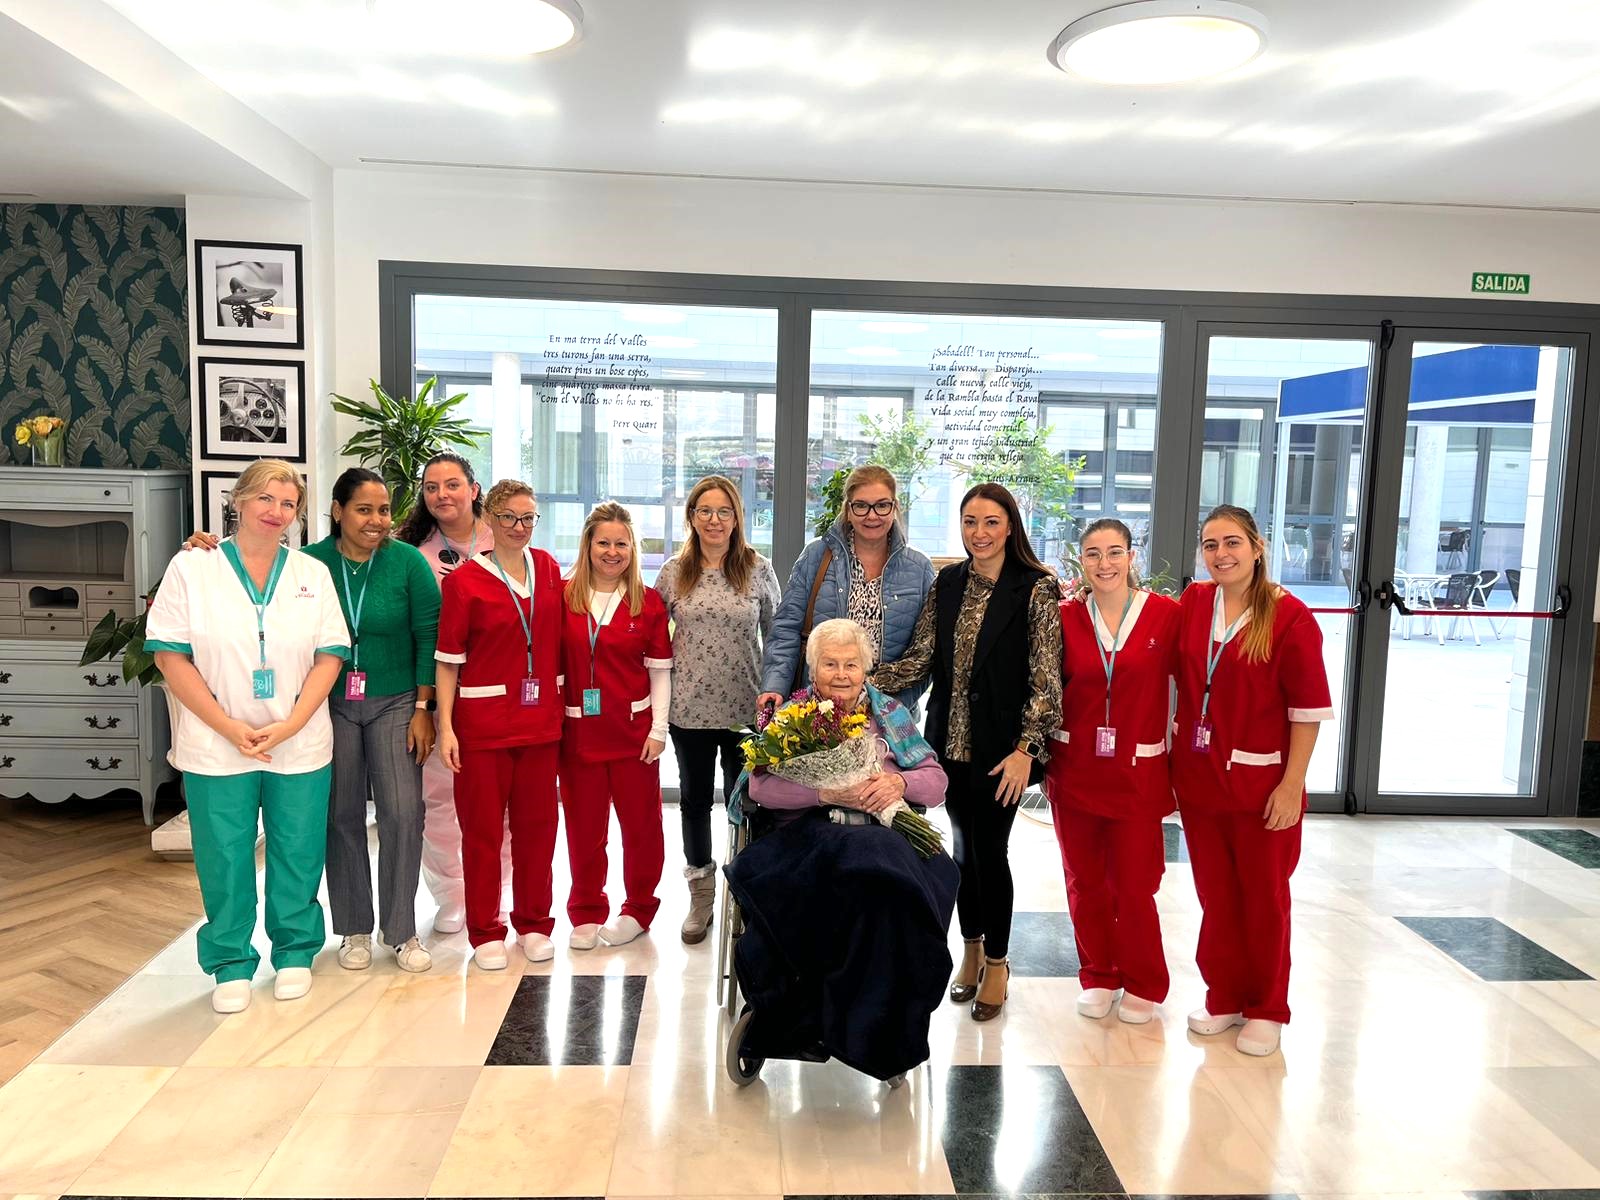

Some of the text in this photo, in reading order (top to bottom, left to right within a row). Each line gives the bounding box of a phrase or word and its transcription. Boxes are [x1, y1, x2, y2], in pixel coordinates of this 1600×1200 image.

[1475, 275, 1525, 291] SALIDA
[580, 336, 601, 344] terra
[604, 333, 618, 345] del
[544, 350, 558, 358] tres
[561, 351, 588, 359] turons
[588, 348, 605, 363] fan
[628, 353, 652, 363] serra,
[933, 345, 1039, 363] ¡Sabadell! Tan personal...
[546, 365, 572, 378] quatre
[574, 365, 592, 379] pins
[610, 364, 625, 375] bosc
[628, 365, 649, 381] espès,
[929, 361, 1042, 378] Tan diversa... Dispareja...
[561, 381, 598, 394] quarteres
[629, 382, 652, 391] terra.
[936, 375, 1033, 391] Calle nueva, calle vieja,
[561, 392, 570, 403] el
[616, 394, 623, 405] hi
[627, 394, 635, 406] ha
[925, 389, 934, 401] de
[937, 390, 945, 401] la
[948, 390, 979, 402] Rambla
[982, 391, 1002, 402] hasta
[1006, 391, 1014, 402] el
[931, 404, 1036, 423] Vida social muy compleja,
[613, 420, 657, 433] Pere Quart
[945, 420, 1022, 432] actividad comercial
[923, 438, 934, 450] y
[949, 440, 969, 450] gran
[972, 435, 993, 449] tejido
[995, 436, 1038, 447] industrial
[939, 453, 952, 465] que
[956, 452, 964, 460] tu
